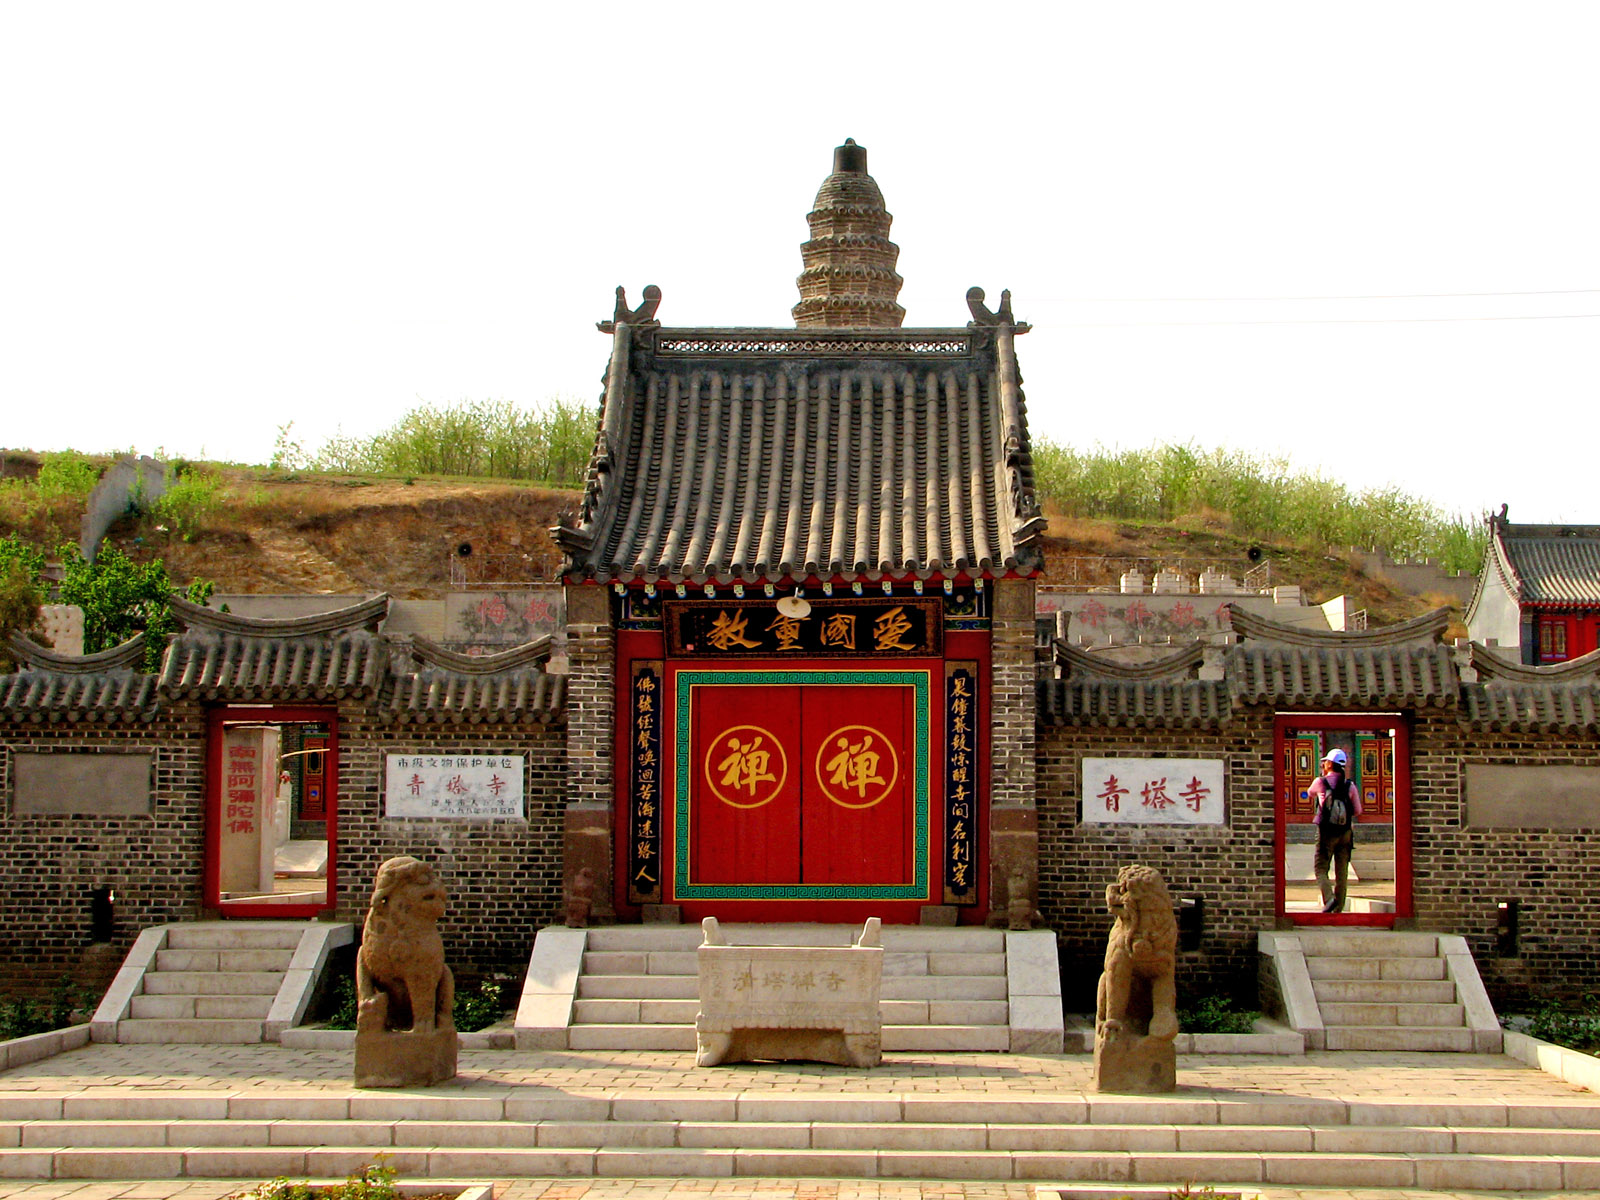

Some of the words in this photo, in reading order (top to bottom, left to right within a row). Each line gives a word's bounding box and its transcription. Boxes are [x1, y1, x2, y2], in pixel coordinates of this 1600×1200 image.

[406, 773, 506, 796] 青塔寺
[1096, 774, 1211, 813] 青塔寺
